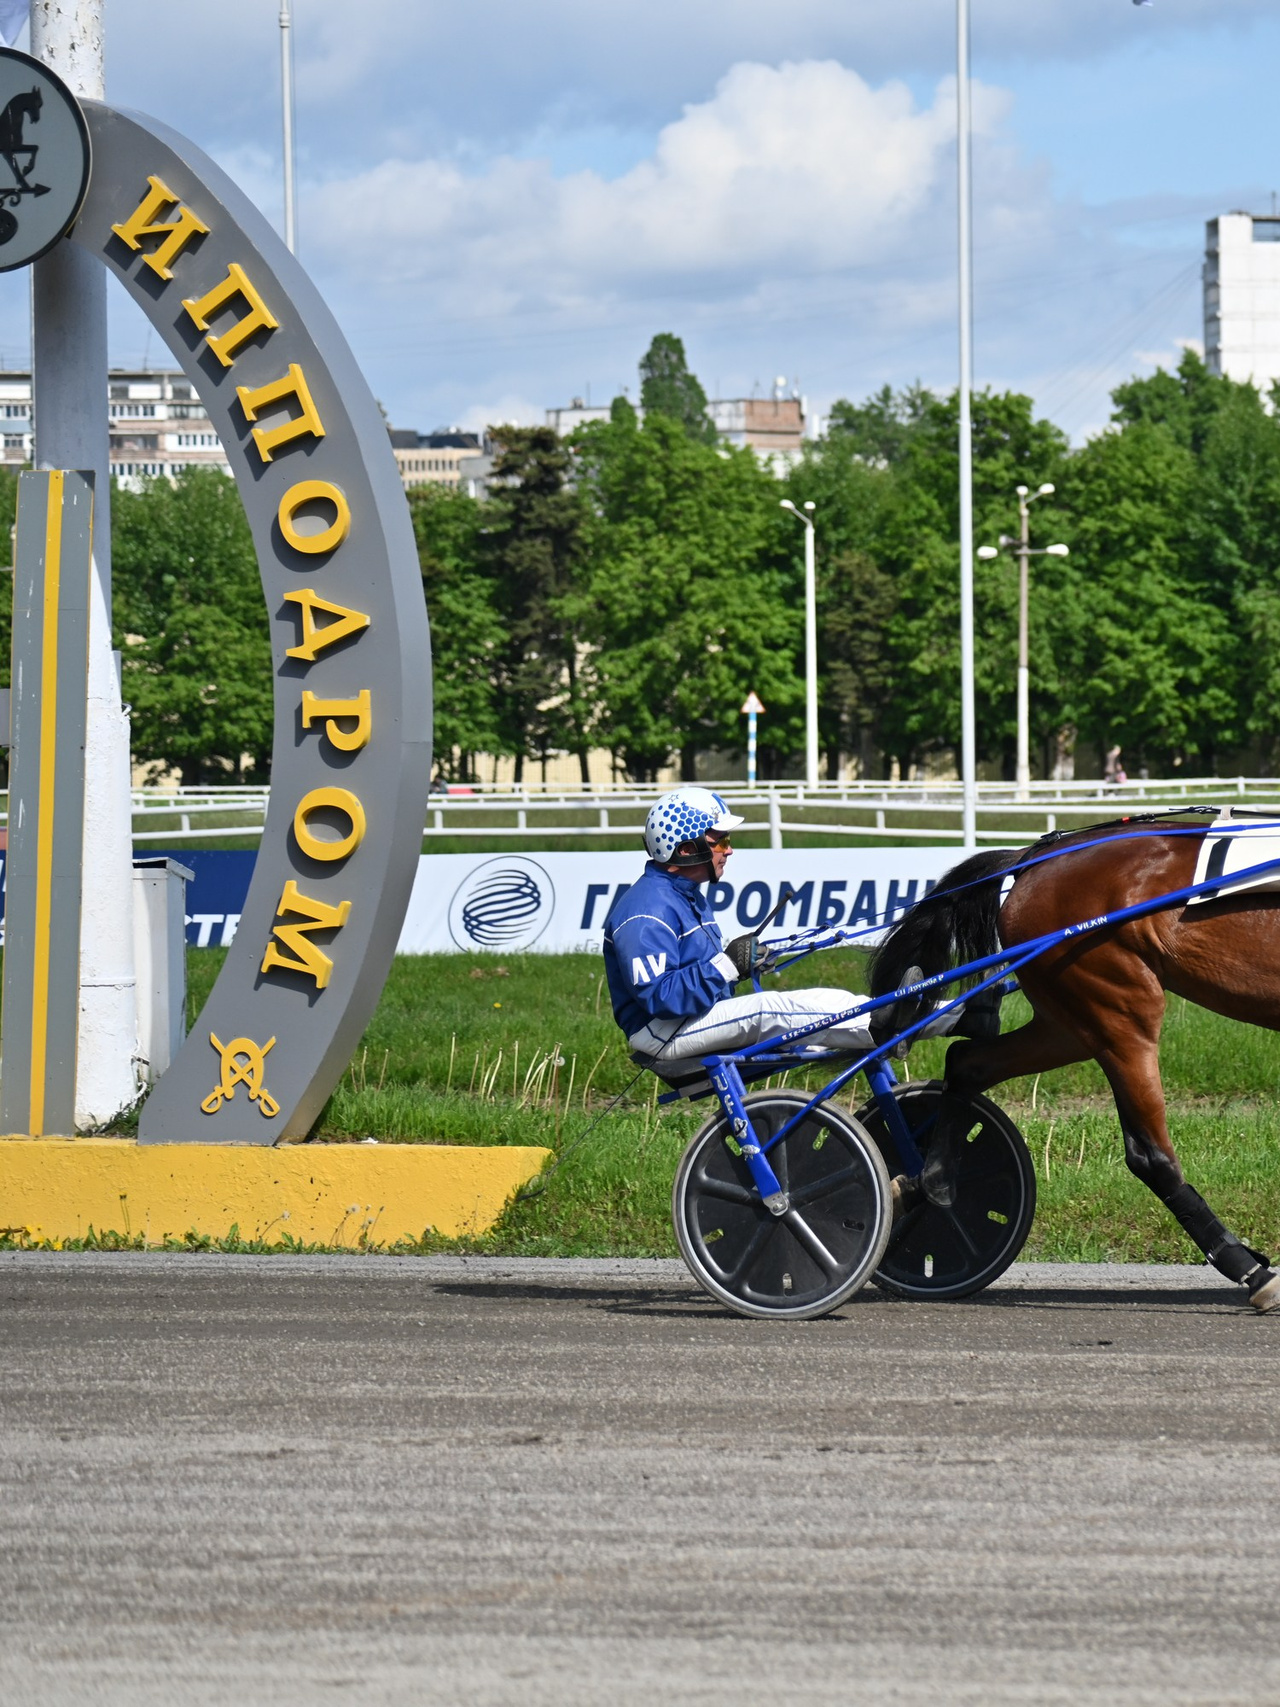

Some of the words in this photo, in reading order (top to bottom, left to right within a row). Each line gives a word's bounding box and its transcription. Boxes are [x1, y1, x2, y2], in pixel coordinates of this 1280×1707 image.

[111, 175, 372, 989] ИППОДРОМ
[580, 880, 937, 929] ГРОМБАН
[1076, 915, 1108, 931] VILKIN
